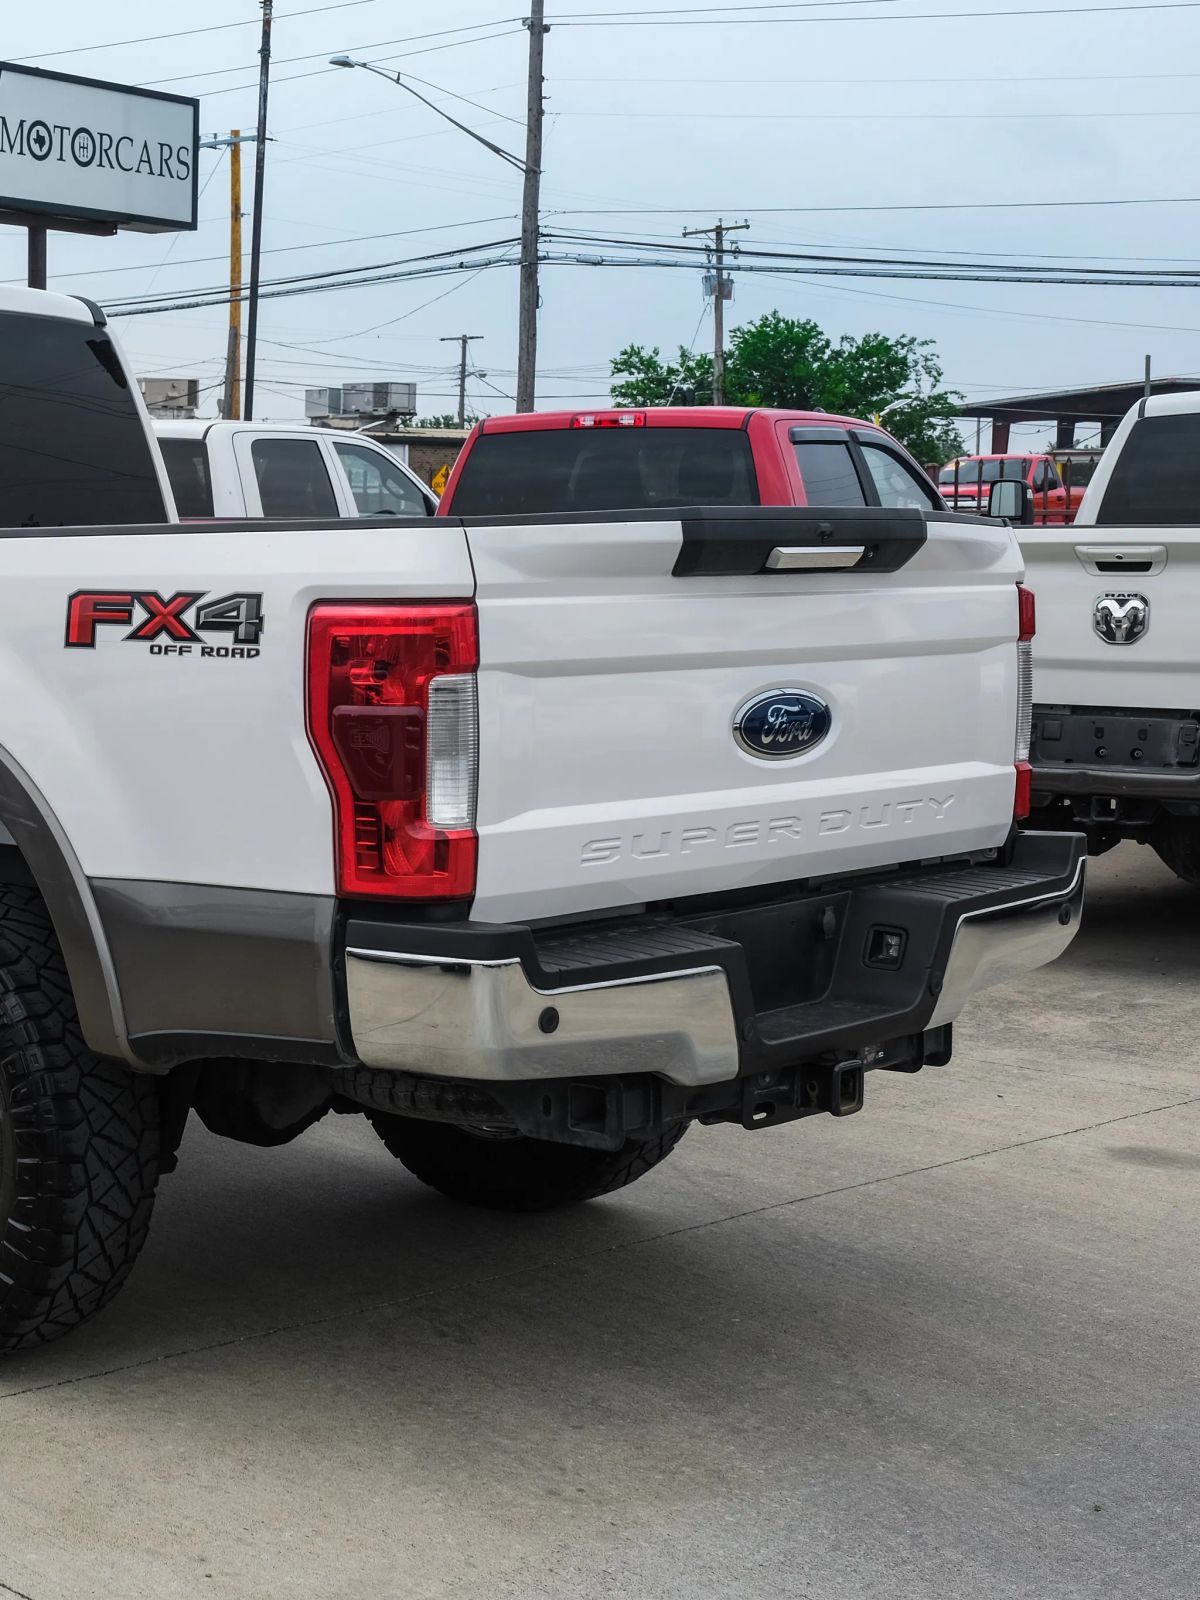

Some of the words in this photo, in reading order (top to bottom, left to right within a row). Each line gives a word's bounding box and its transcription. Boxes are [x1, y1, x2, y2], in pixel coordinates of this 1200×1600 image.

[64, 588, 265, 649] FX4
[150, 644, 193, 656] OFF
[200, 645, 261, 659] ROAD
[760, 703, 816, 745] Ford
[579, 814, 804, 867] SUPER
[817, 793, 955, 836] DUTY
